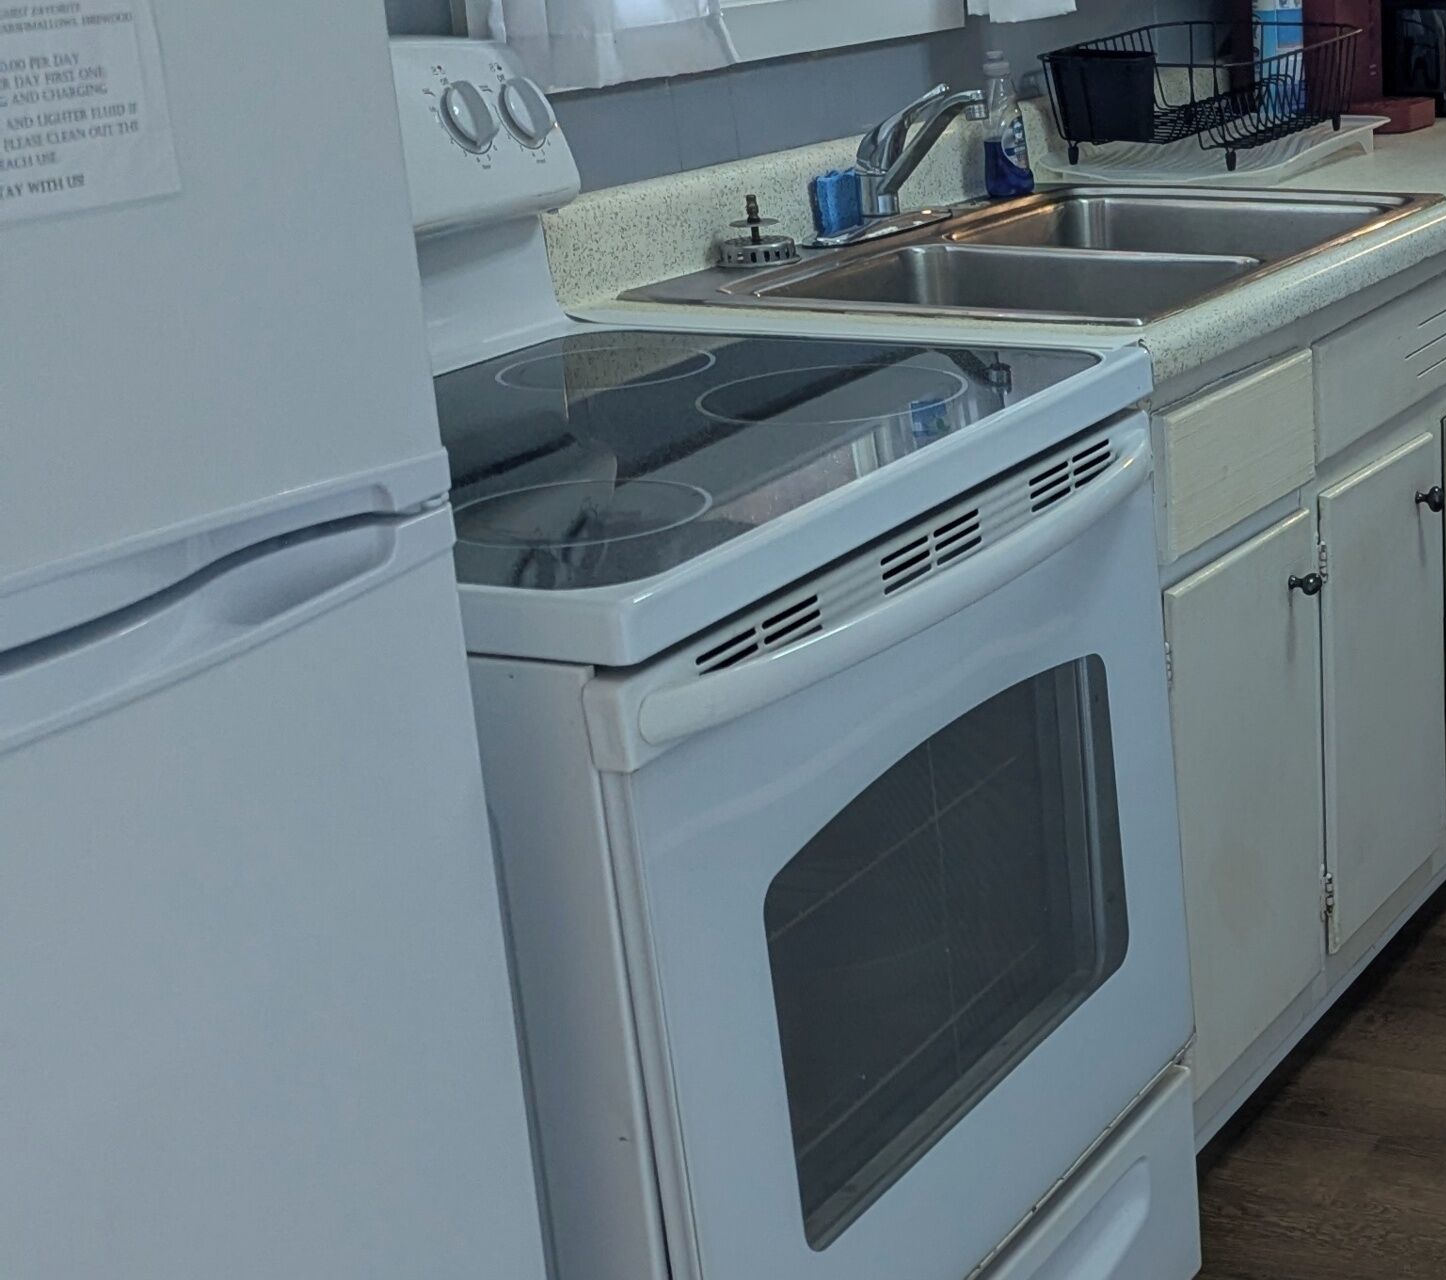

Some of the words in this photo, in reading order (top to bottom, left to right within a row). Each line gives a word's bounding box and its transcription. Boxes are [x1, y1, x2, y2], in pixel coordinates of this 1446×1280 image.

[53, 53, 80, 68] DAY
[14, 74, 42, 90] DAY
[45, 70, 76, 86] FIRST
[78, 65, 107, 82] ONE
[12, 88, 40, 105] AND
[42, 83, 108, 103] CHARGING
[6, 114, 34, 131] AND
[37, 107, 88, 128] LIGHTER
[4, 132, 43, 153] PLEASE
[46, 126, 86, 145] CLEAN
[89, 122, 114, 140] OUT
[27, 176, 64, 196] WITH
